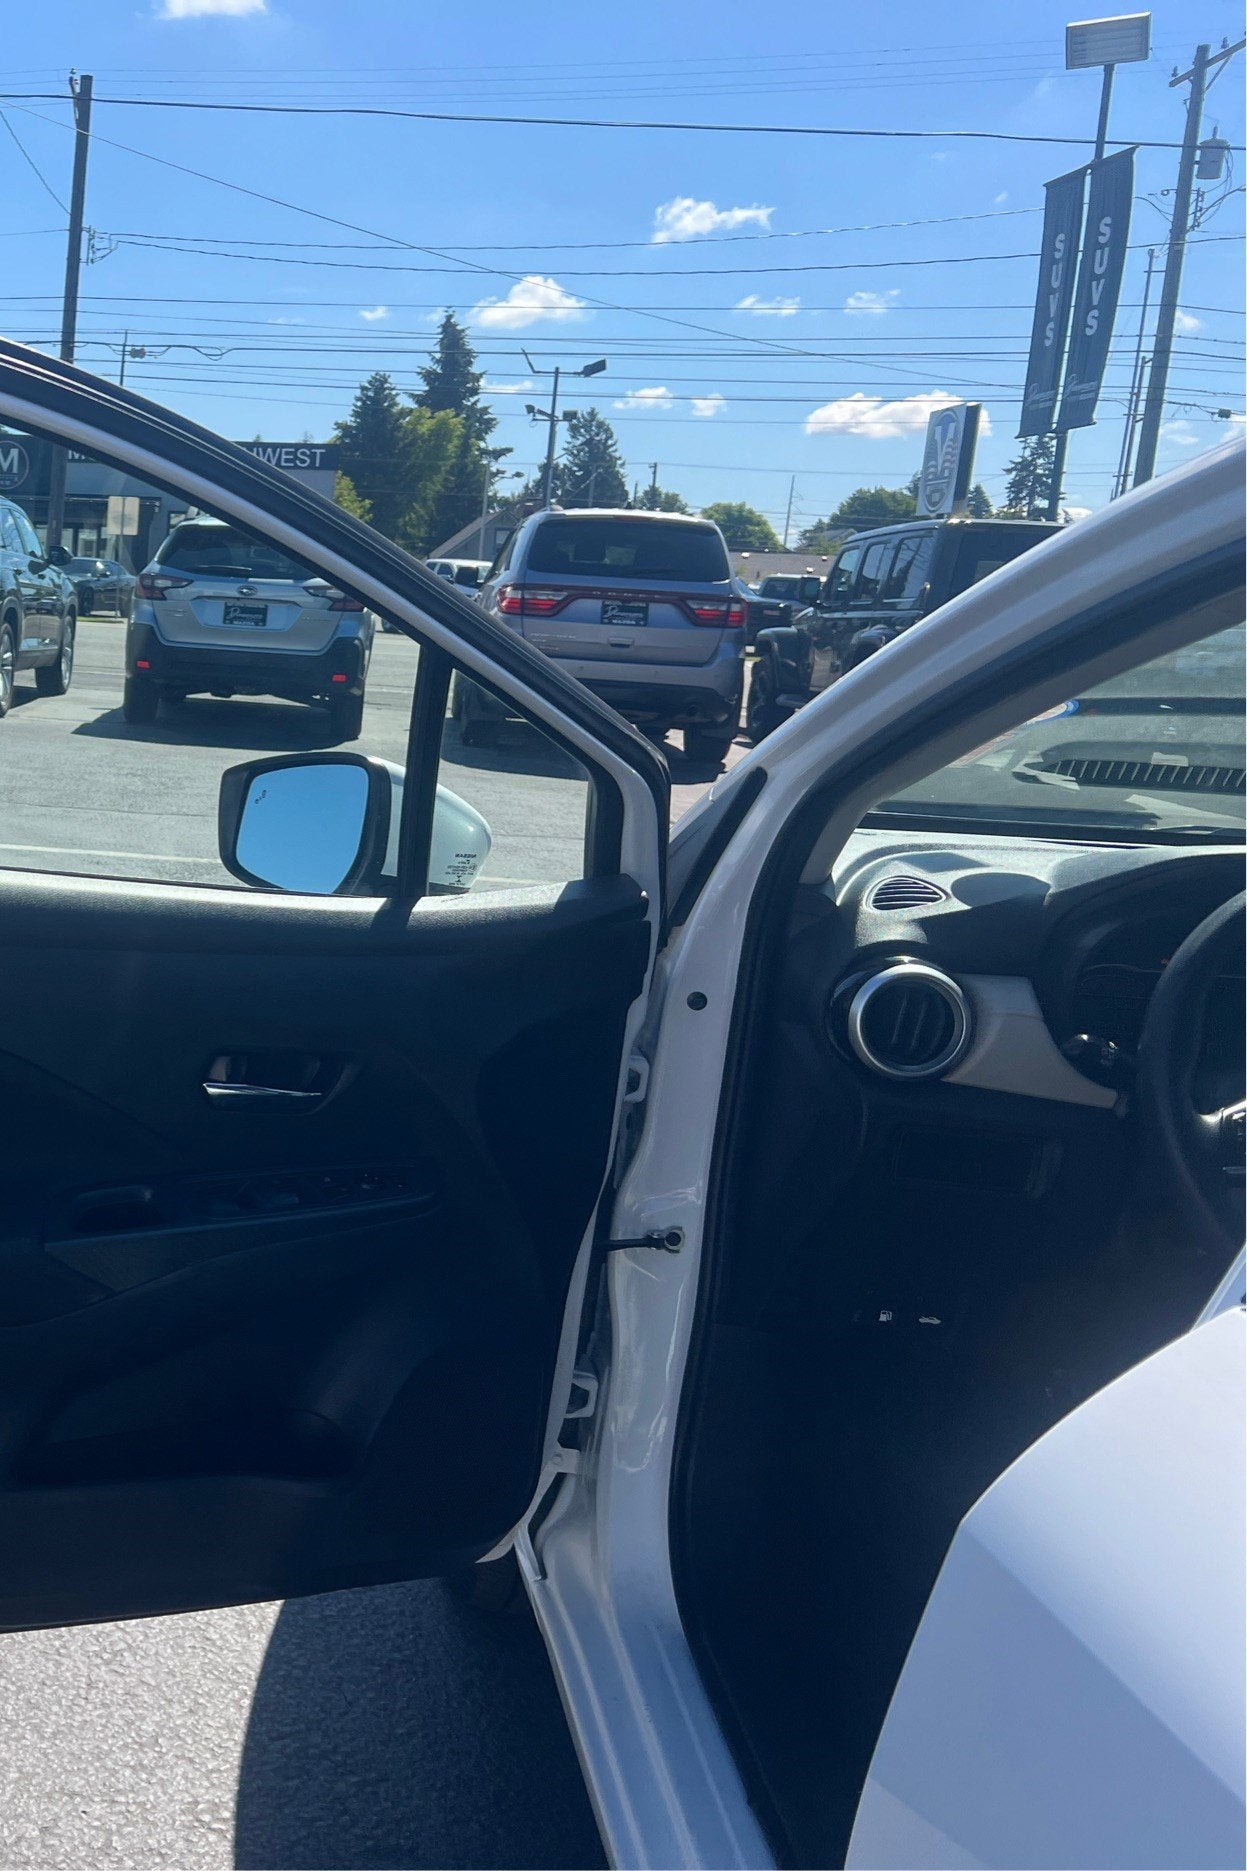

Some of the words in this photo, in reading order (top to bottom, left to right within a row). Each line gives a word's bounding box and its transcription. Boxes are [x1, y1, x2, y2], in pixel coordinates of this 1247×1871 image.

[1044, 233, 1066, 347] SUVS
[1085, 216, 1112, 336] SUVS
[253, 447, 326, 467] WEST
